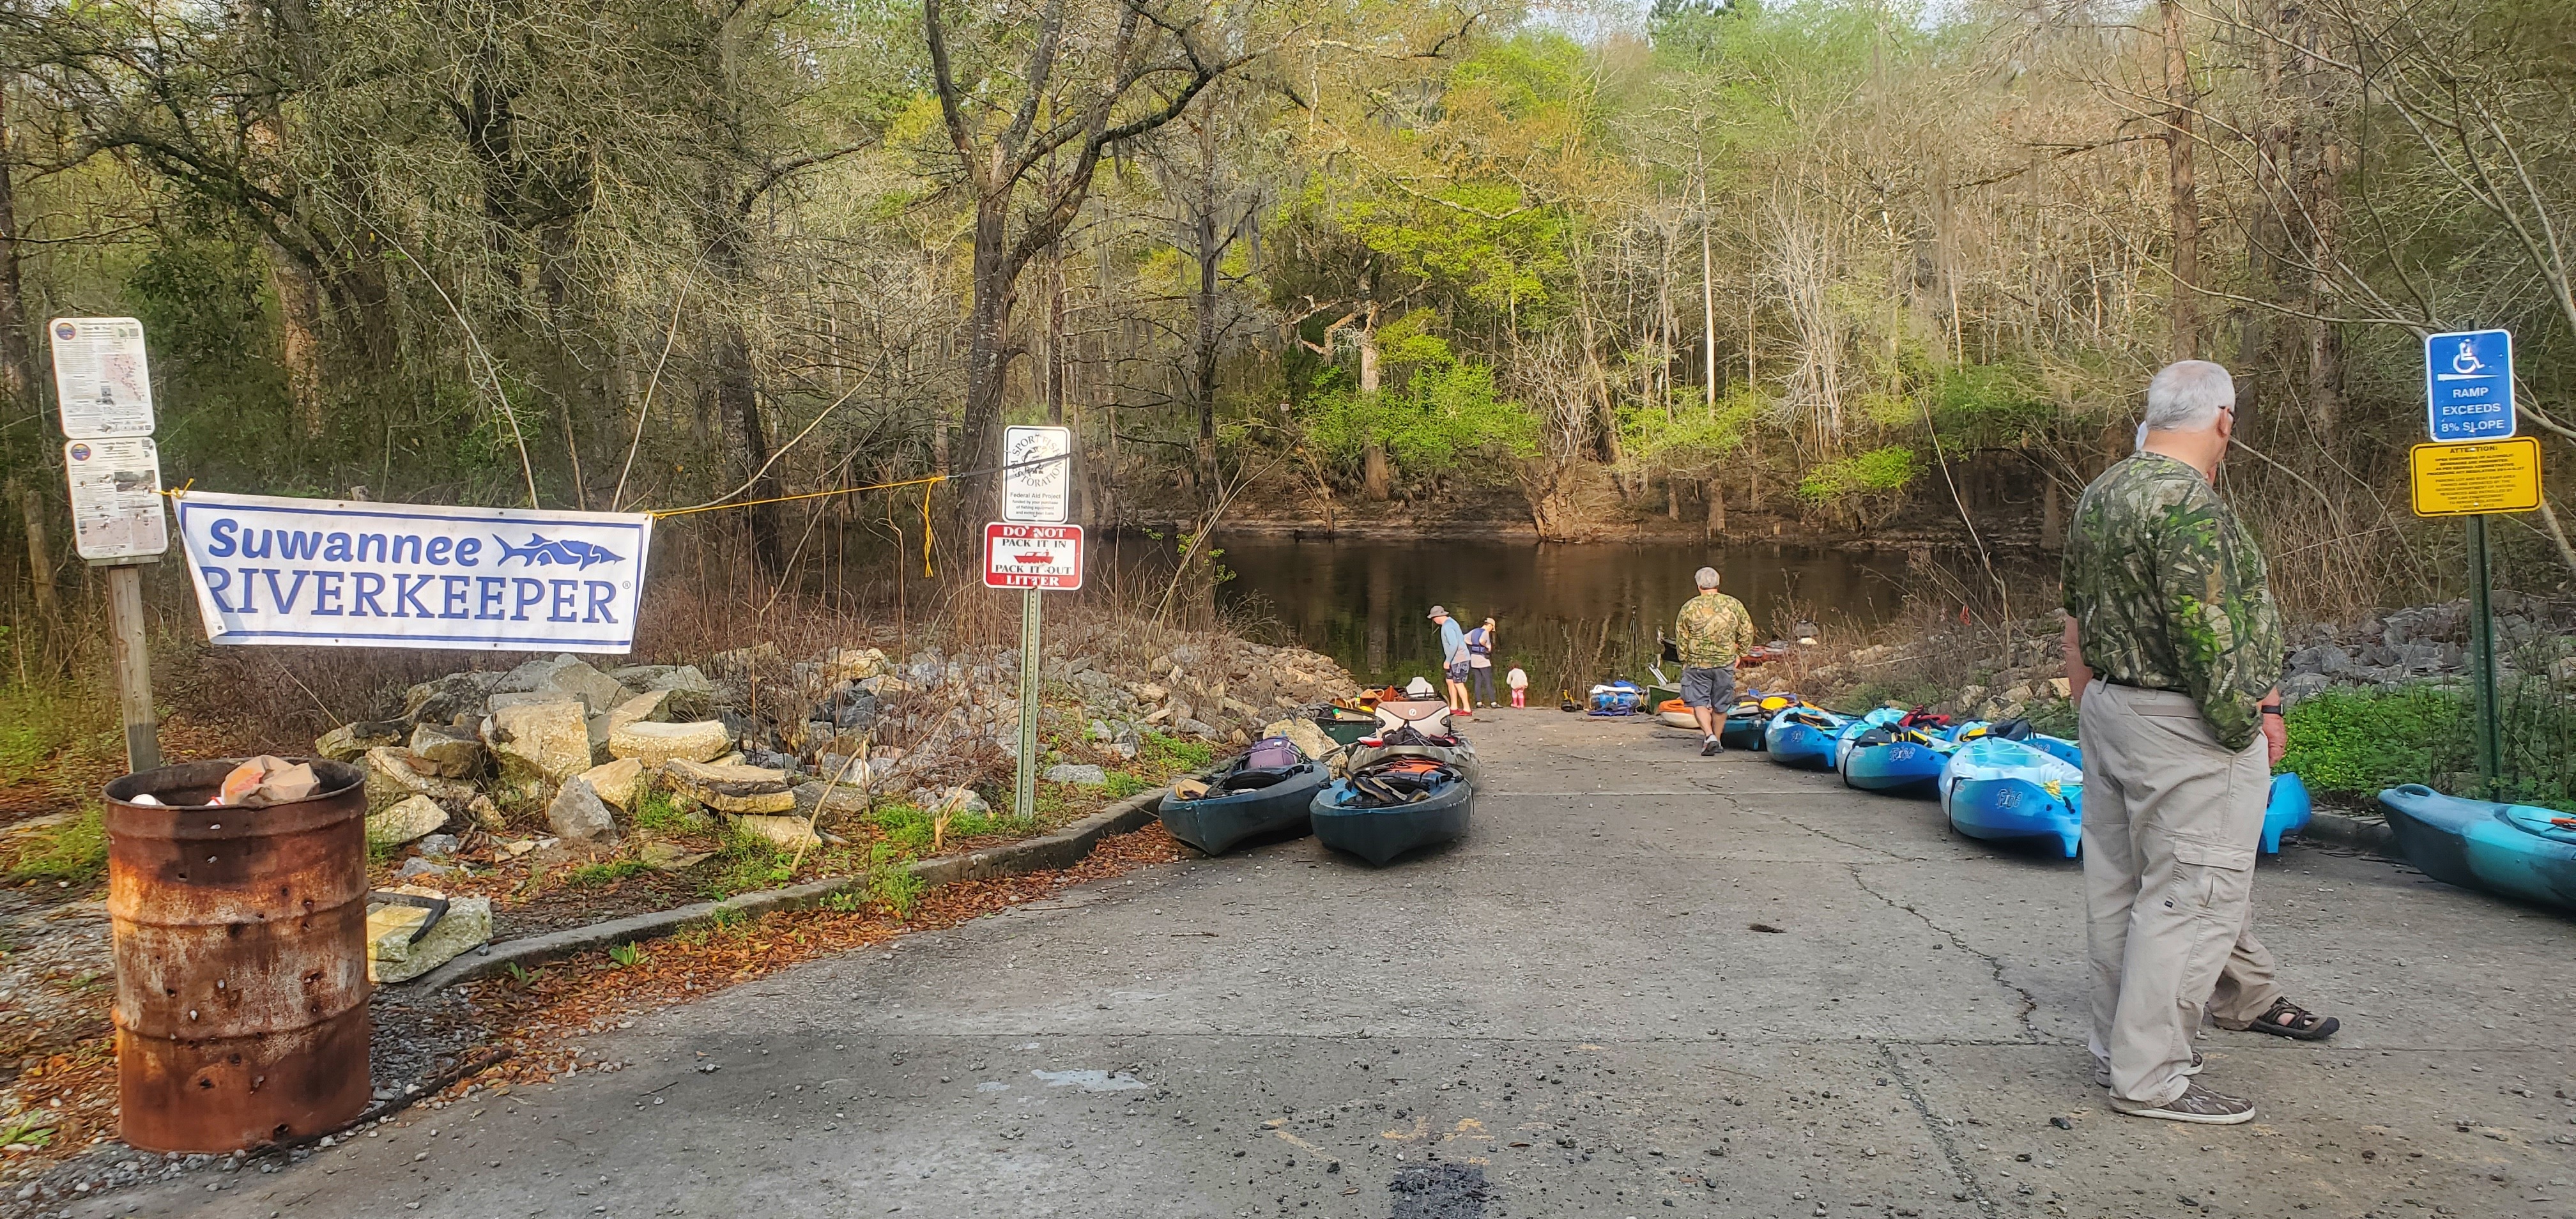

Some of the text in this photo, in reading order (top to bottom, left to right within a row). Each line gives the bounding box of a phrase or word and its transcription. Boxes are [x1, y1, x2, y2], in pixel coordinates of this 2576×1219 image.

[2453, 387, 2488, 398] RAMP
[2443, 403, 2501, 415] EXCEEDS
[2441, 419, 2505, 432] 8% SLOPE
[1003, 527, 1066, 538] DO NOT
[209, 518, 482, 566] Suwannee
[1002, 539, 1031, 547] PACK
[995, 565, 1024, 573] PACK
[1006, 575, 1060, 586] LITTER
